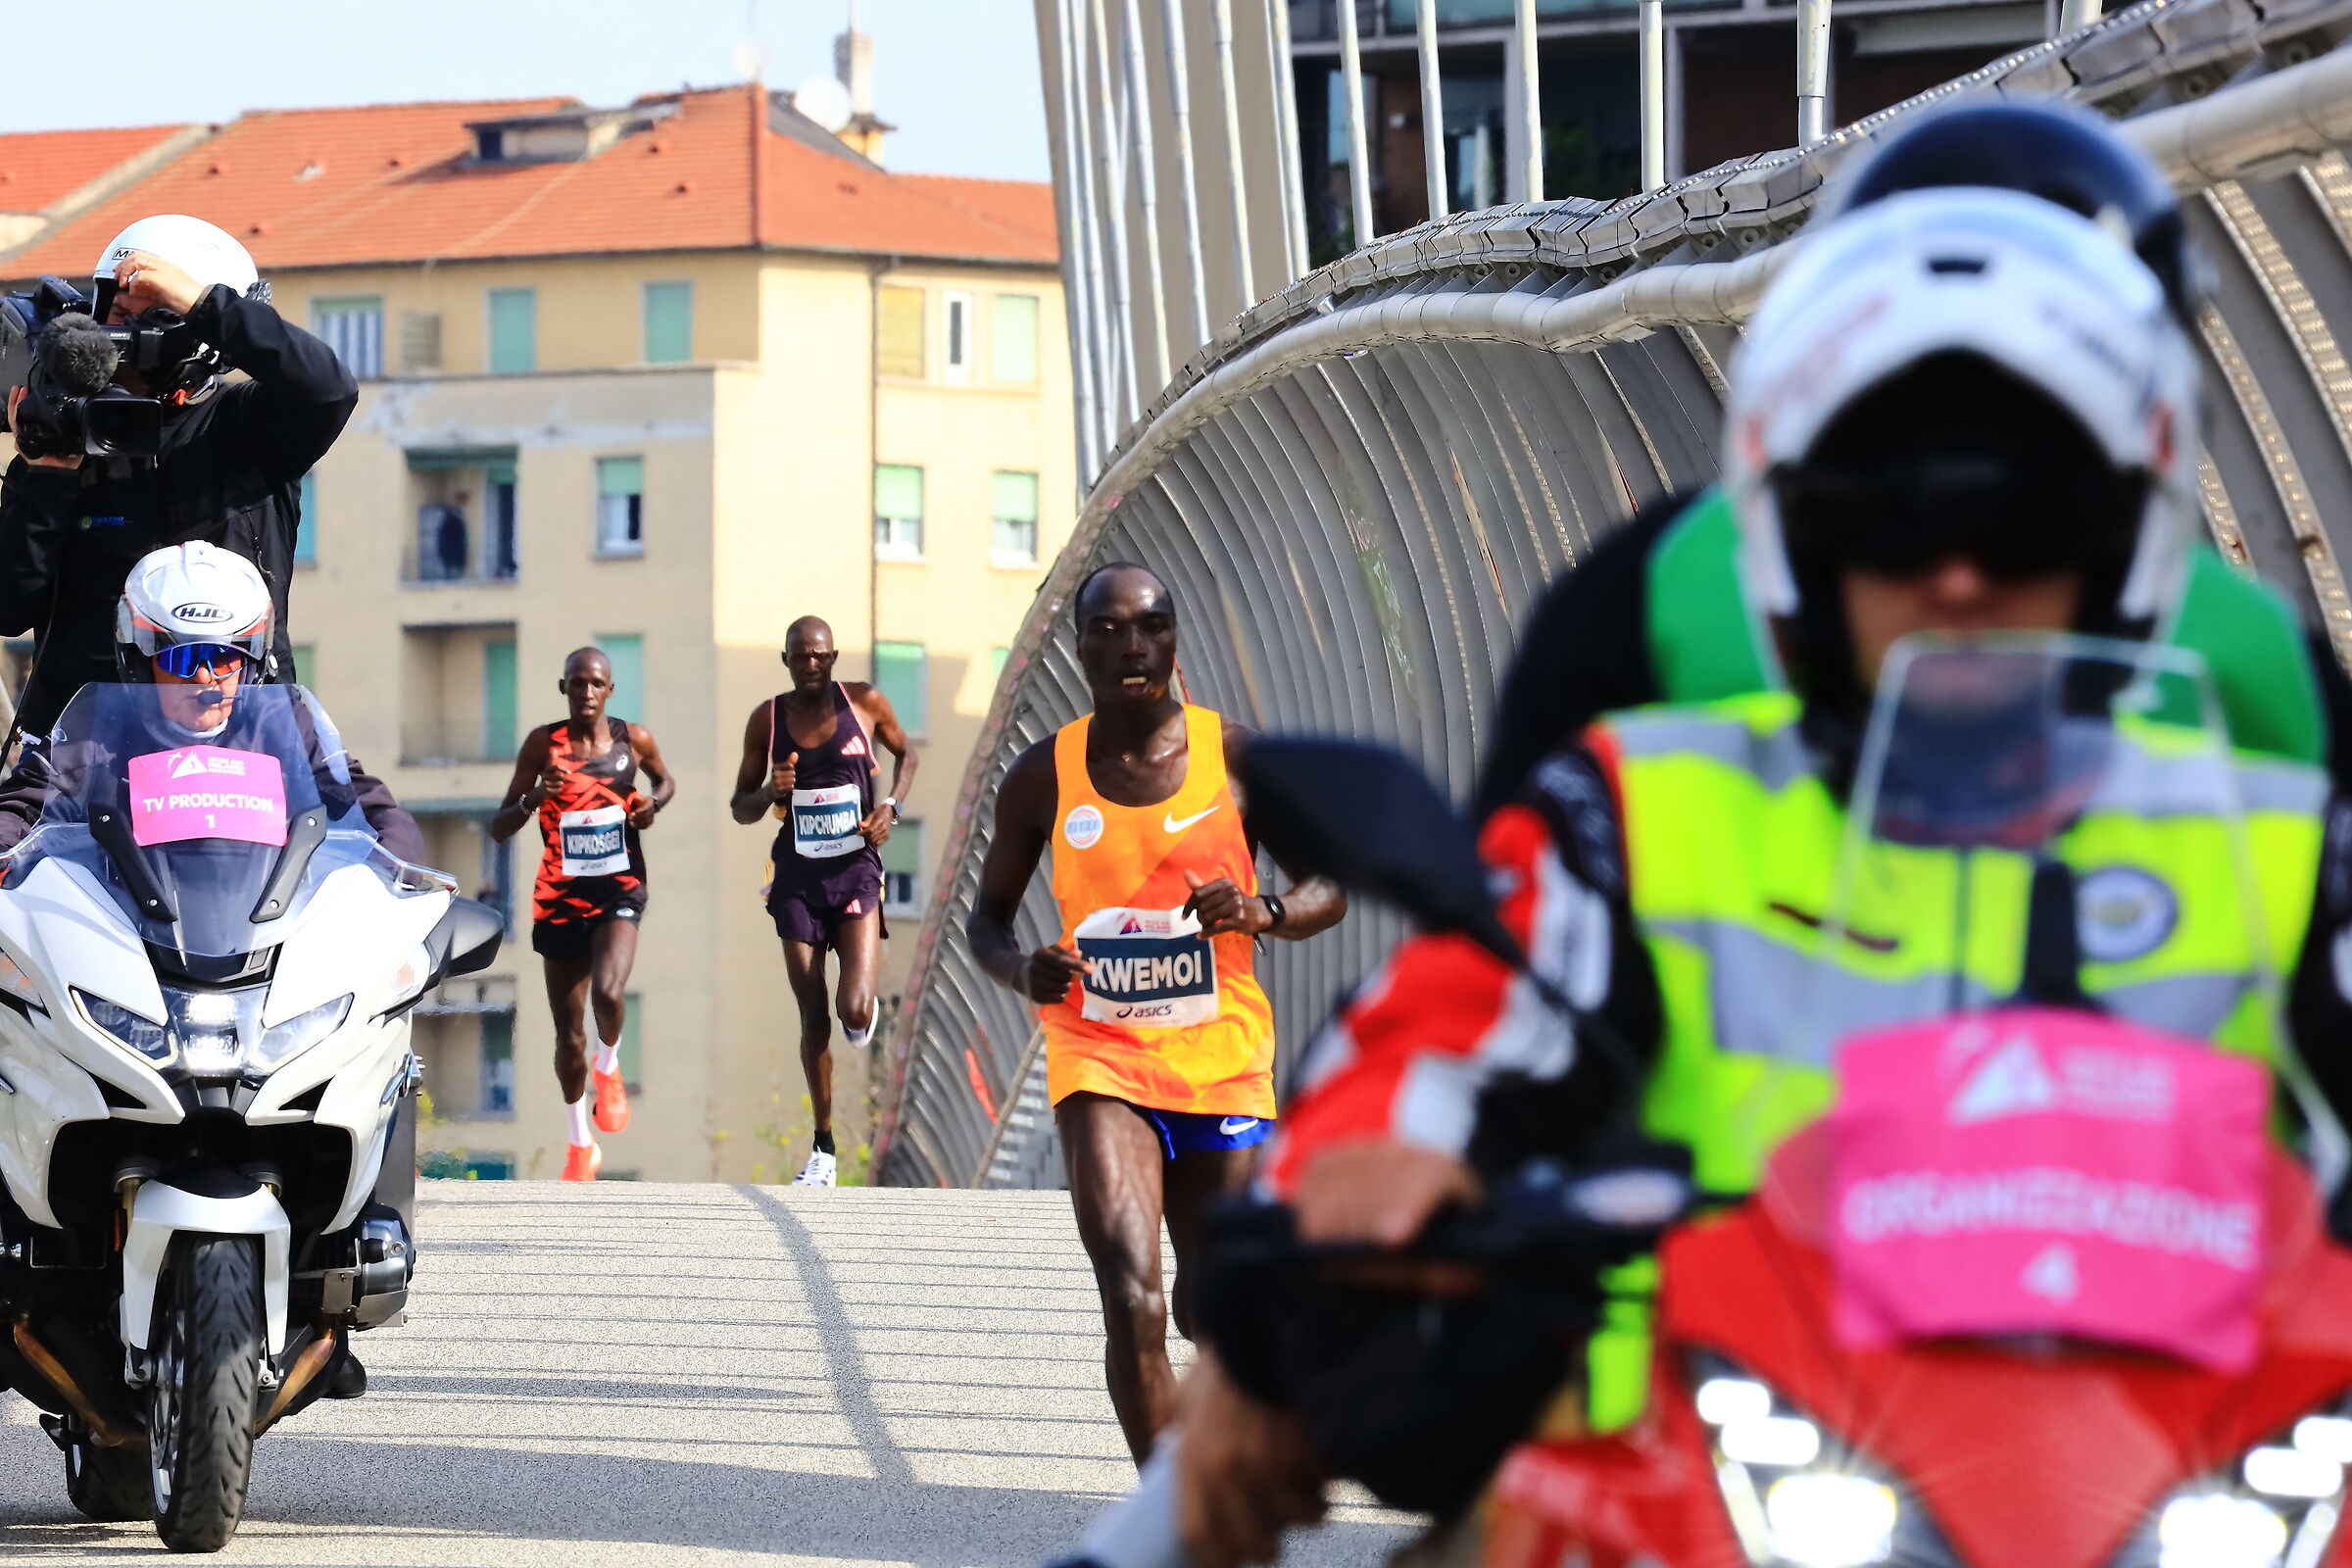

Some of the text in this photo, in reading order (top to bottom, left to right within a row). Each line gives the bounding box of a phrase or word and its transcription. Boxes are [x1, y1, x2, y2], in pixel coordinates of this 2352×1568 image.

[179, 608, 225, 618] HJC
[143, 793, 273, 812] TV PRODUCTION
[205, 814, 216, 829] 1
[798, 808, 858, 836] KIPCHUMBA
[566, 829, 620, 856] KIPKOSGEI
[1088, 950, 1202, 994] KWEMOI
[1135, 1004, 1172, 1017] asics
[2023, 1240, 2078, 1305] 4
